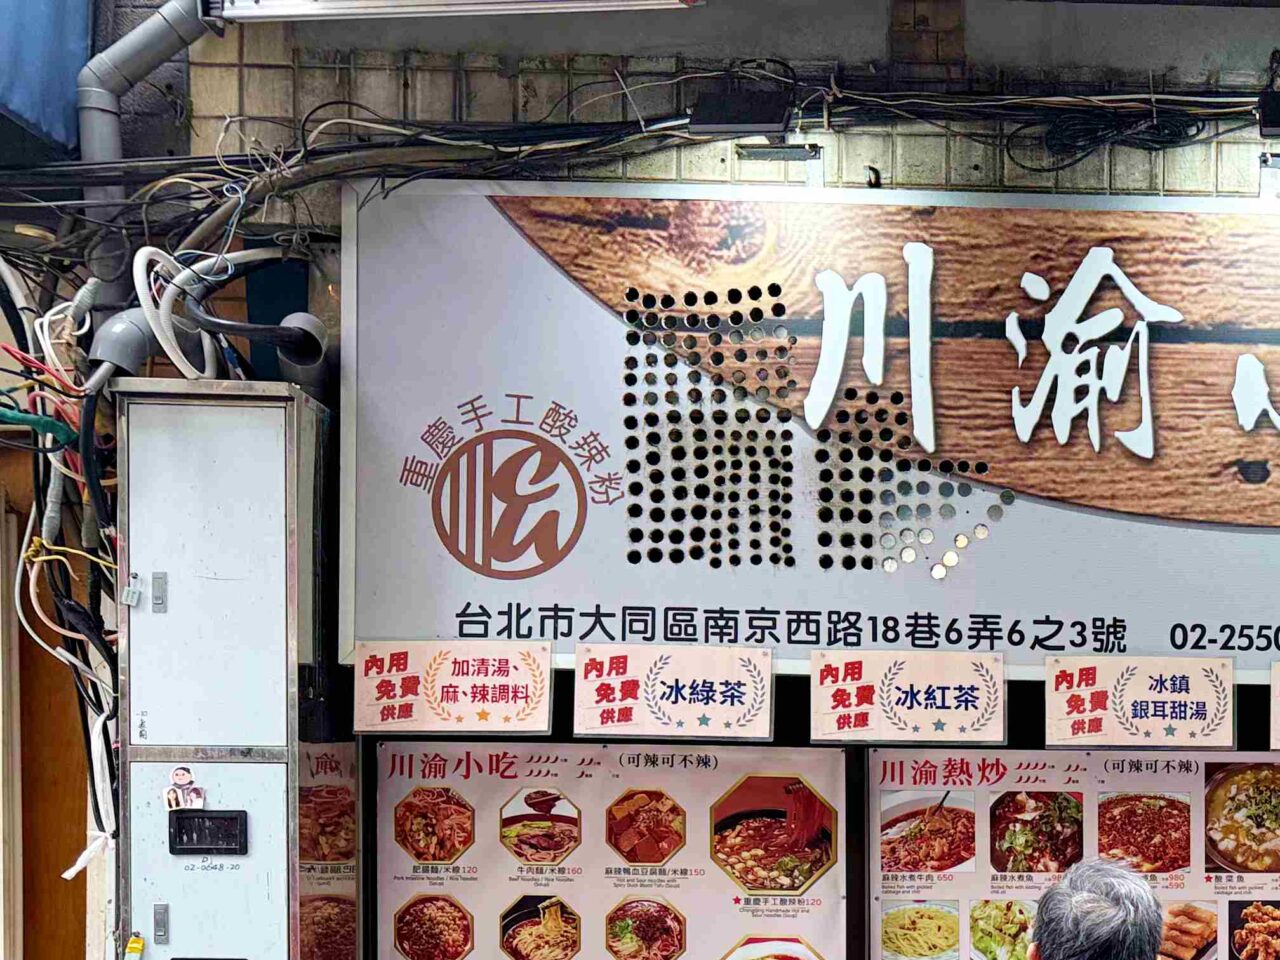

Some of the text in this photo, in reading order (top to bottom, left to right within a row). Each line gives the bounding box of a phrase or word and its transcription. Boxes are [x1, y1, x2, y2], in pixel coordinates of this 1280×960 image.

[399, 393, 626, 506] 重慶手工酸辣粉
[455, 601, 1128, 655] 台北市大同區南京西路18巷6弄6之3號
[376, 677, 421, 700] 免費
[440, 682, 531, 705] 麻、辣調料
[595, 679, 641, 704] 免費
[659, 678, 747, 706] 冰綠茶
[1148, 673, 1191, 695] 冰鎮
[831, 685, 875, 710] 免費
[894, 682, 980, 711] 冰紅茶
[1065, 691, 1110, 715] 免費
[379, 705, 414, 722] 供應
[599, 707, 634, 725] 供應
[1131, 700, 1208, 721] 銀耳甜湯
[836, 711, 870, 731] 供應
[1070, 717, 1104, 736] 供應
[388, 751, 519, 780] 川渝小吃
[618, 752, 719, 770] (可辣可不辣)
[880, 756, 1007, 786] 川渝熱炒
[1103, 758, 1200, 775] (可辣可不辣)
[462, 867, 478, 875] 120
[567, 867, 583, 875] 160
[690, 868, 706, 876] 150
[937, 874, 954, 882] 650
[1168, 874, 1185, 882] 980
[1168, 882, 1185, 890] 590
[806, 898, 822, 906] 120
